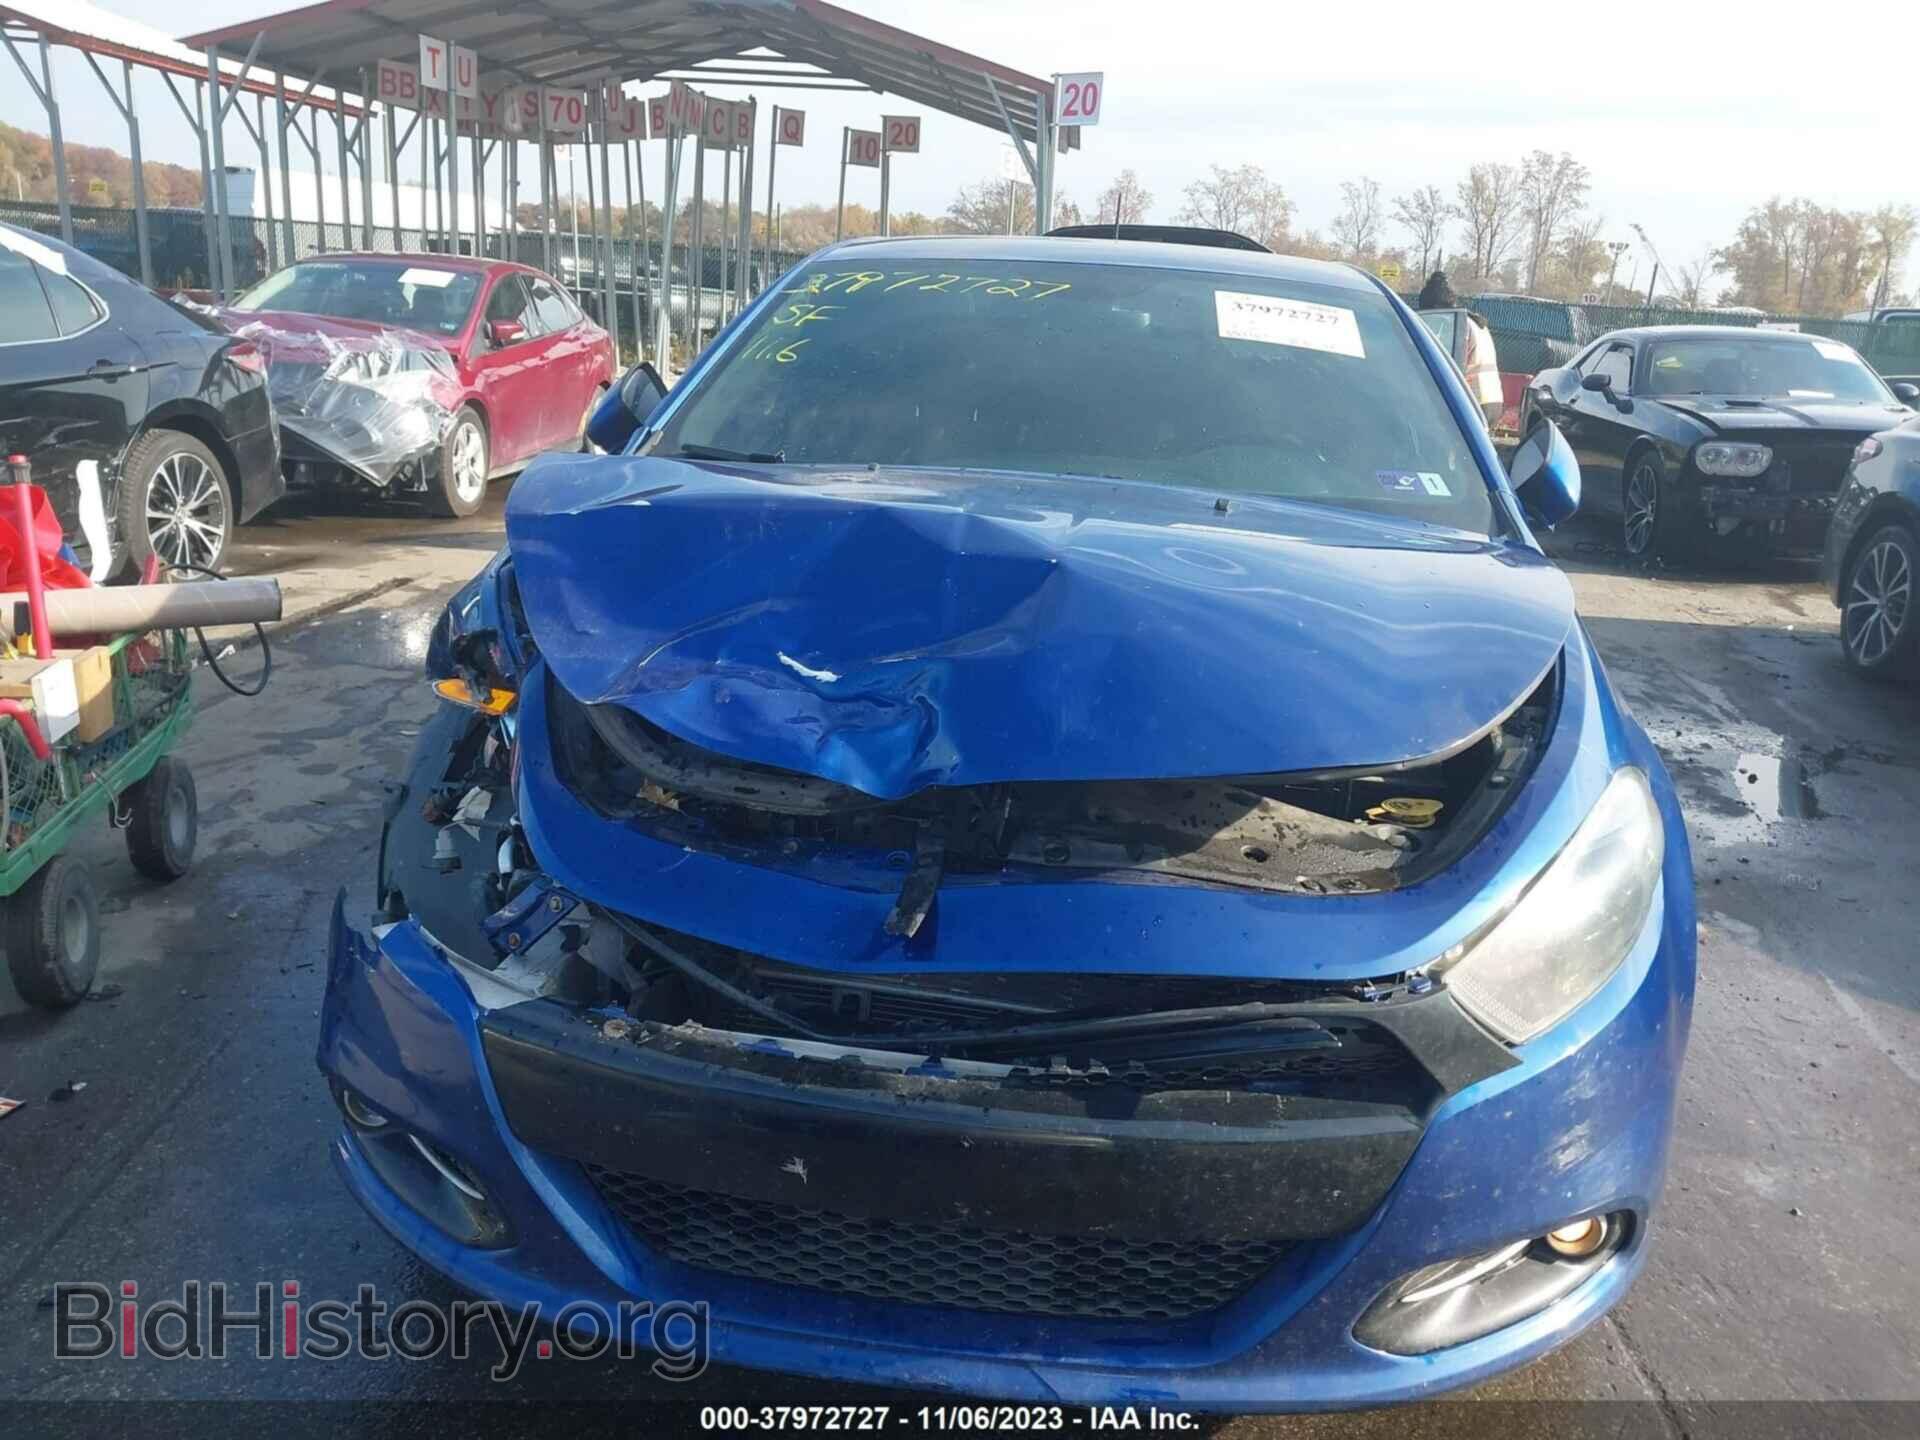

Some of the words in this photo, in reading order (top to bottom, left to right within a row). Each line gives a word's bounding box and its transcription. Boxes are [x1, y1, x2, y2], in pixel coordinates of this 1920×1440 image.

[426, 47, 441, 79] T
[459, 55, 471, 88] U
[380, 66, 416, 98] BB
[525, 91, 539, 118] S
[549, 96, 582, 124] 70
[1062, 82, 1098, 117] 20
[620, 107, 636, 133] J
[652, 105, 665, 130] B
[713, 108, 724, 135] C
[738, 113, 749, 138] B
[784, 115, 800, 142] Q
[854, 135, 878, 160] 10
[890, 122, 917, 146] 20
[773, 304, 849, 327] SF
[1232, 301, 1339, 325] 37972727
